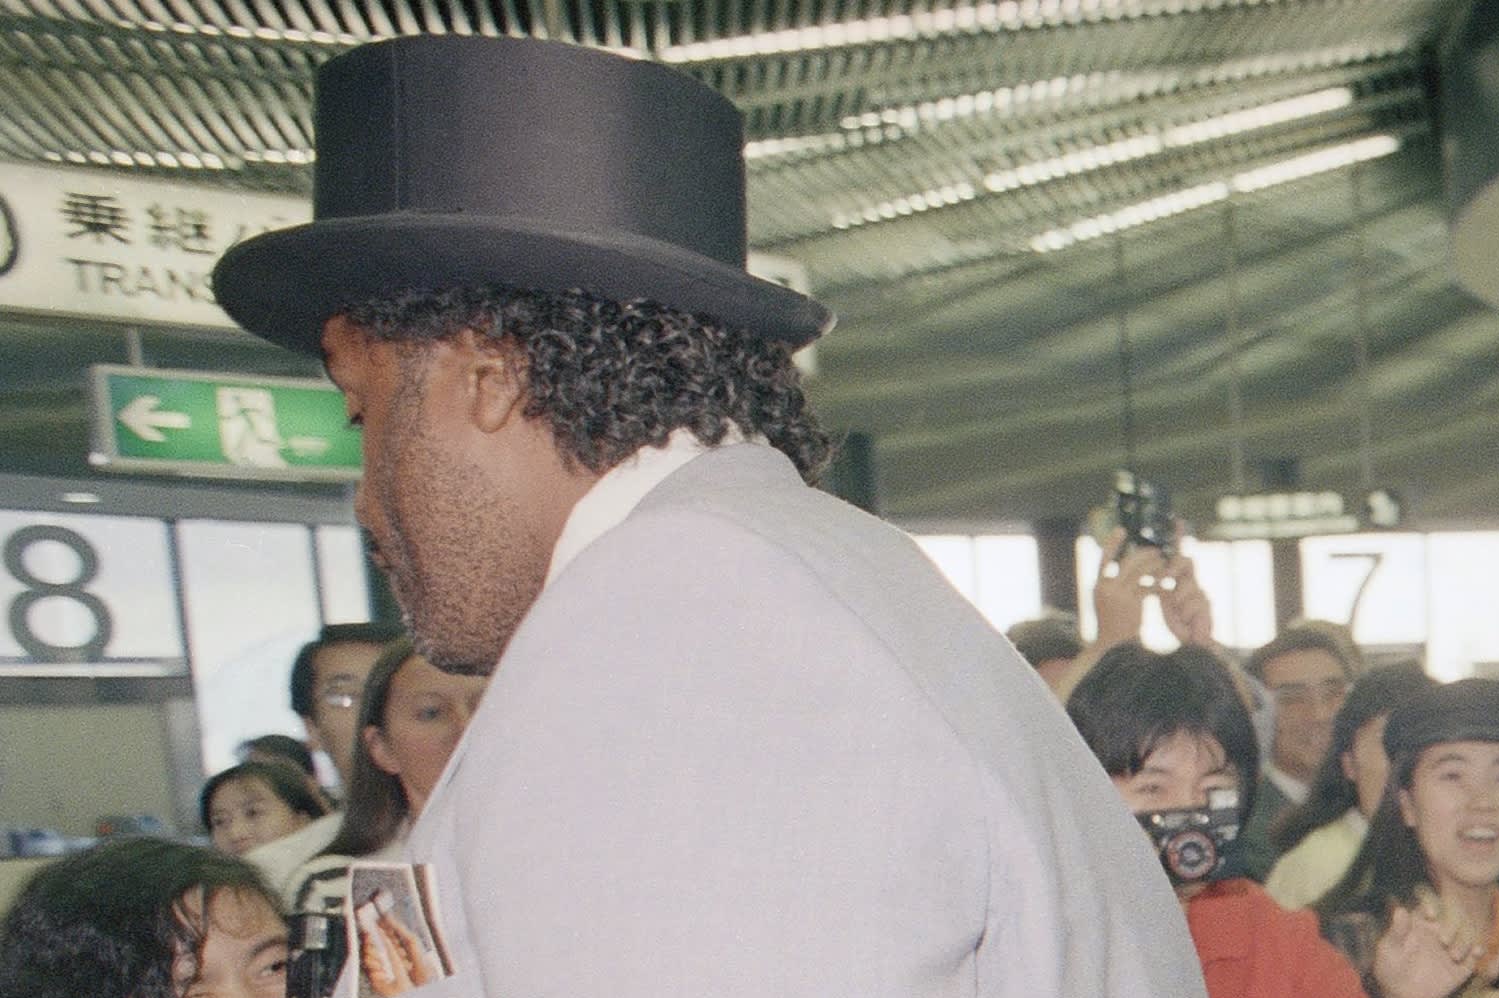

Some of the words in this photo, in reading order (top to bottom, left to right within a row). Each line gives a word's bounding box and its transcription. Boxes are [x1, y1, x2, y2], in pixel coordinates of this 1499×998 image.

[60, 191, 288, 255] 乗継
[3, 524, 113, 663] 8
[1328, 551, 1384, 626] 7
